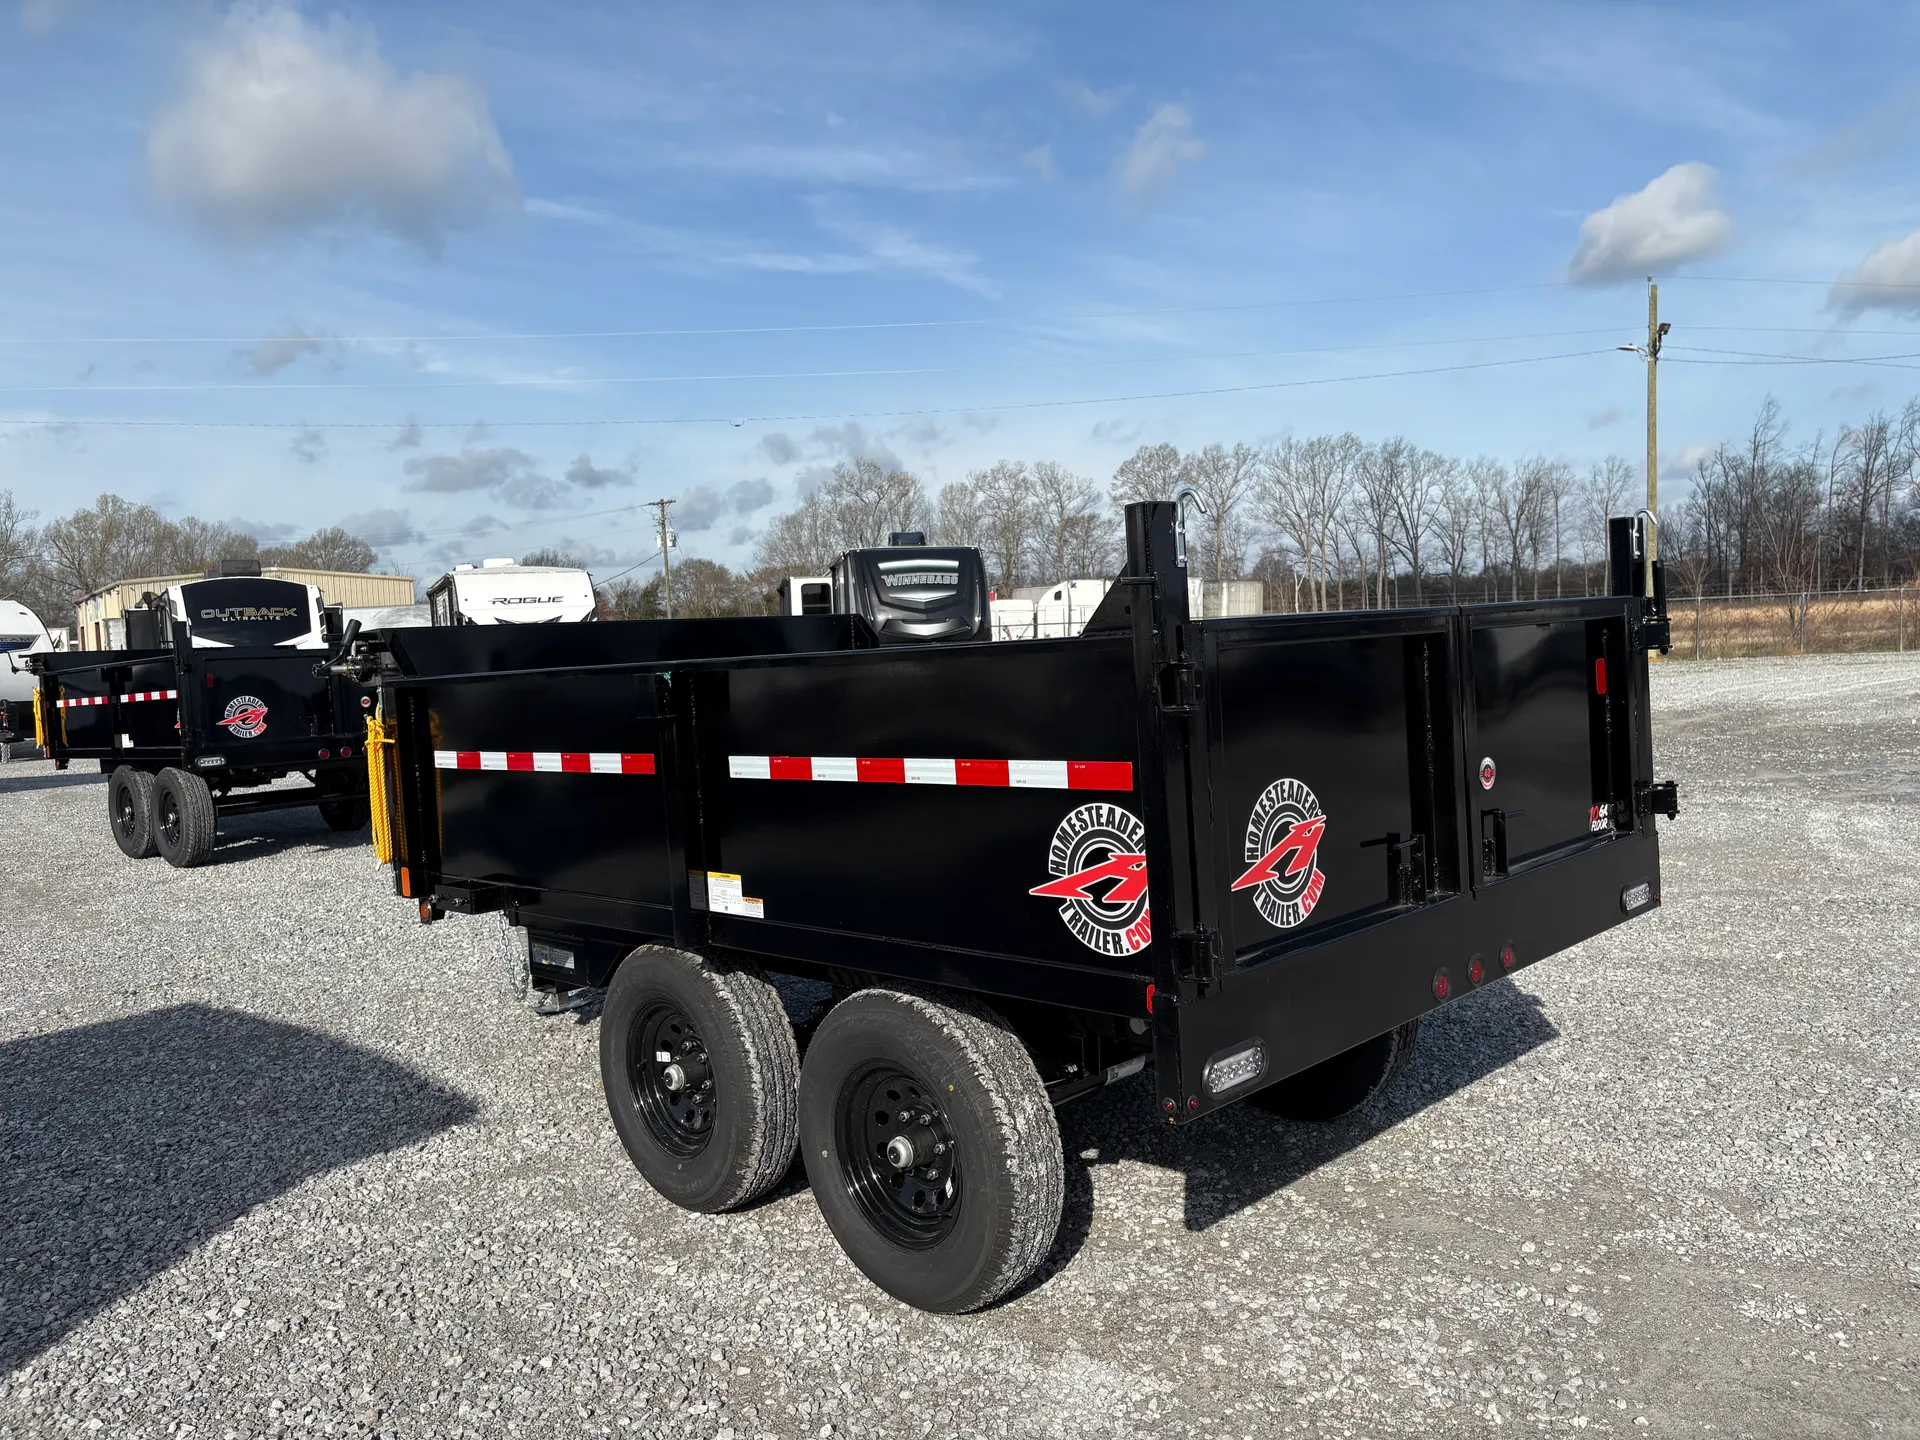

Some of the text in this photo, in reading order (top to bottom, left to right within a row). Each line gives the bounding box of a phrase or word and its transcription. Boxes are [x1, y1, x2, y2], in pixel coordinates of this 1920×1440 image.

[881, 572, 959, 587] WINNEBAGO
[488, 596, 564, 605] ROGUE
[201, 606, 298, 619] OUTBACK
[1246, 780, 1319, 861] HOMESTEADER
[1254, 869, 1326, 926] TRAILER.COM
